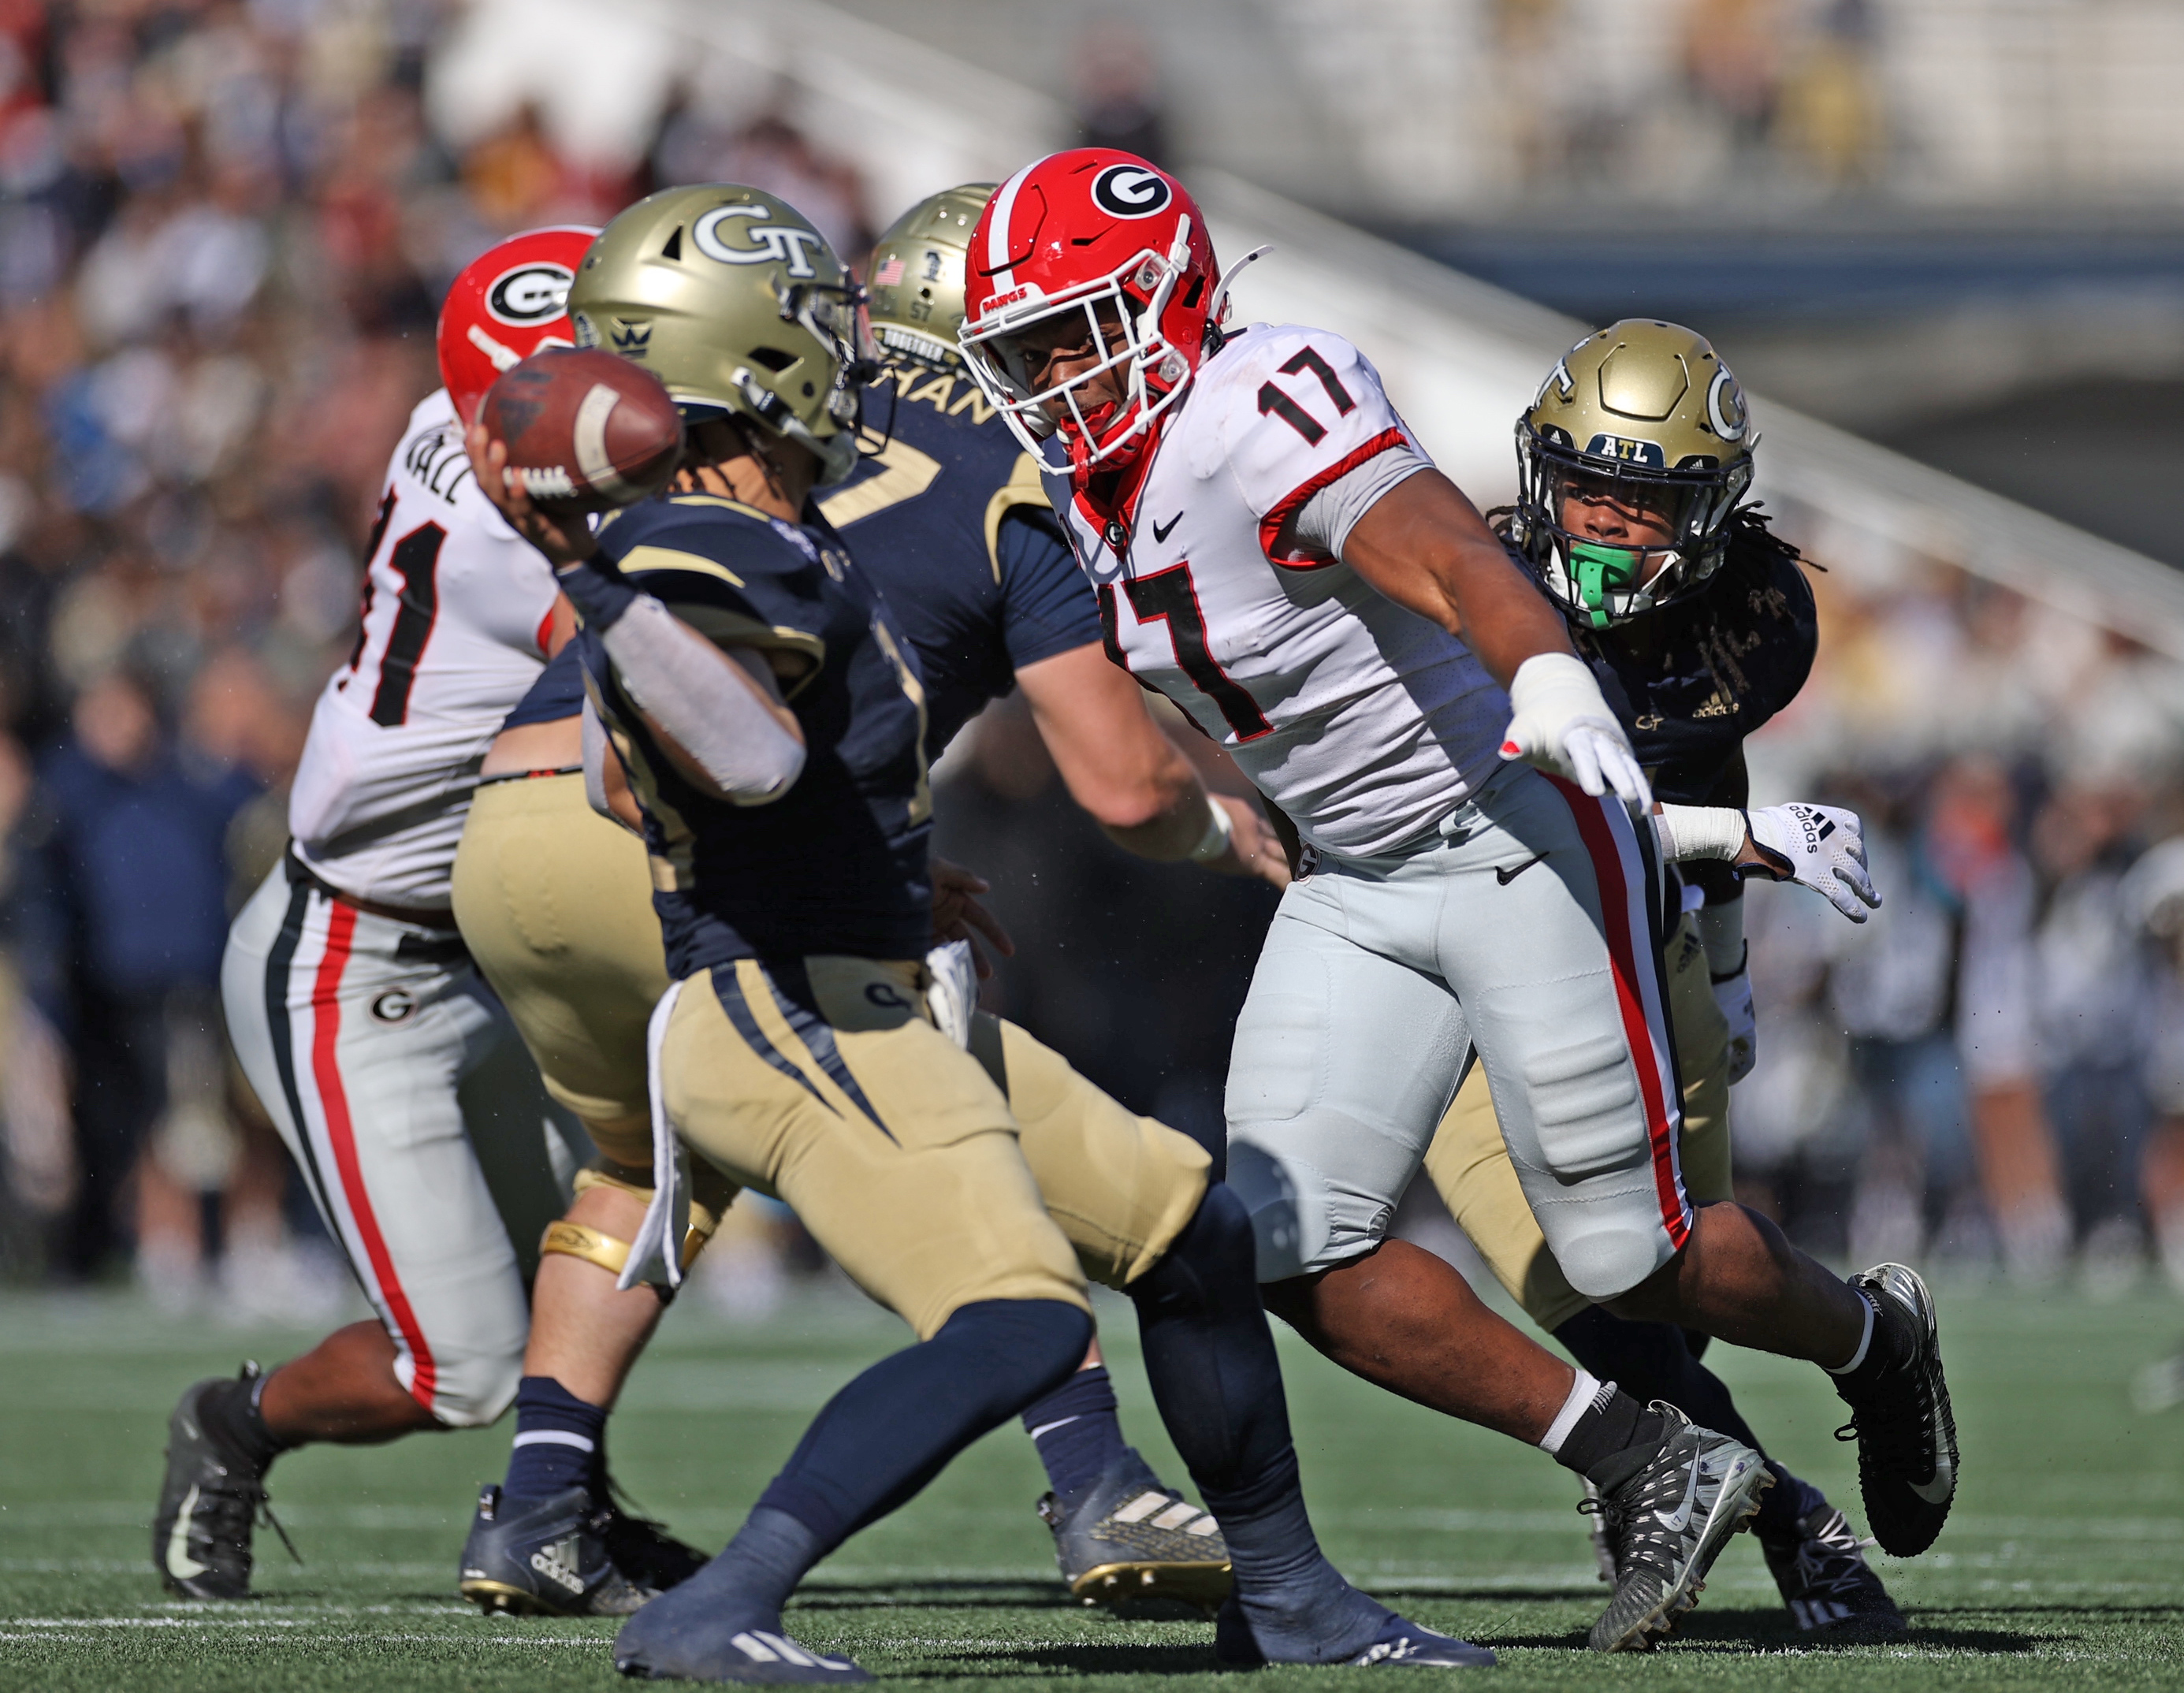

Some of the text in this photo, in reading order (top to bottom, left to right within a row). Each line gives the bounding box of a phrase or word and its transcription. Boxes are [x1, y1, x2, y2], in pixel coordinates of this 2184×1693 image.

[1095, 166, 1169, 216] G
[693, 204, 823, 278] GT
[490, 268, 569, 319] G
[983, 287, 1027, 314] DAWGS
[1257, 345, 1357, 448] 17
[1601, 436, 1648, 463] ATL
[1098, 560, 1275, 743] 17
[1788, 806, 1818, 854] adidas
[372, 989, 415, 1022] G
[530, 1552, 585, 1595] adidas
